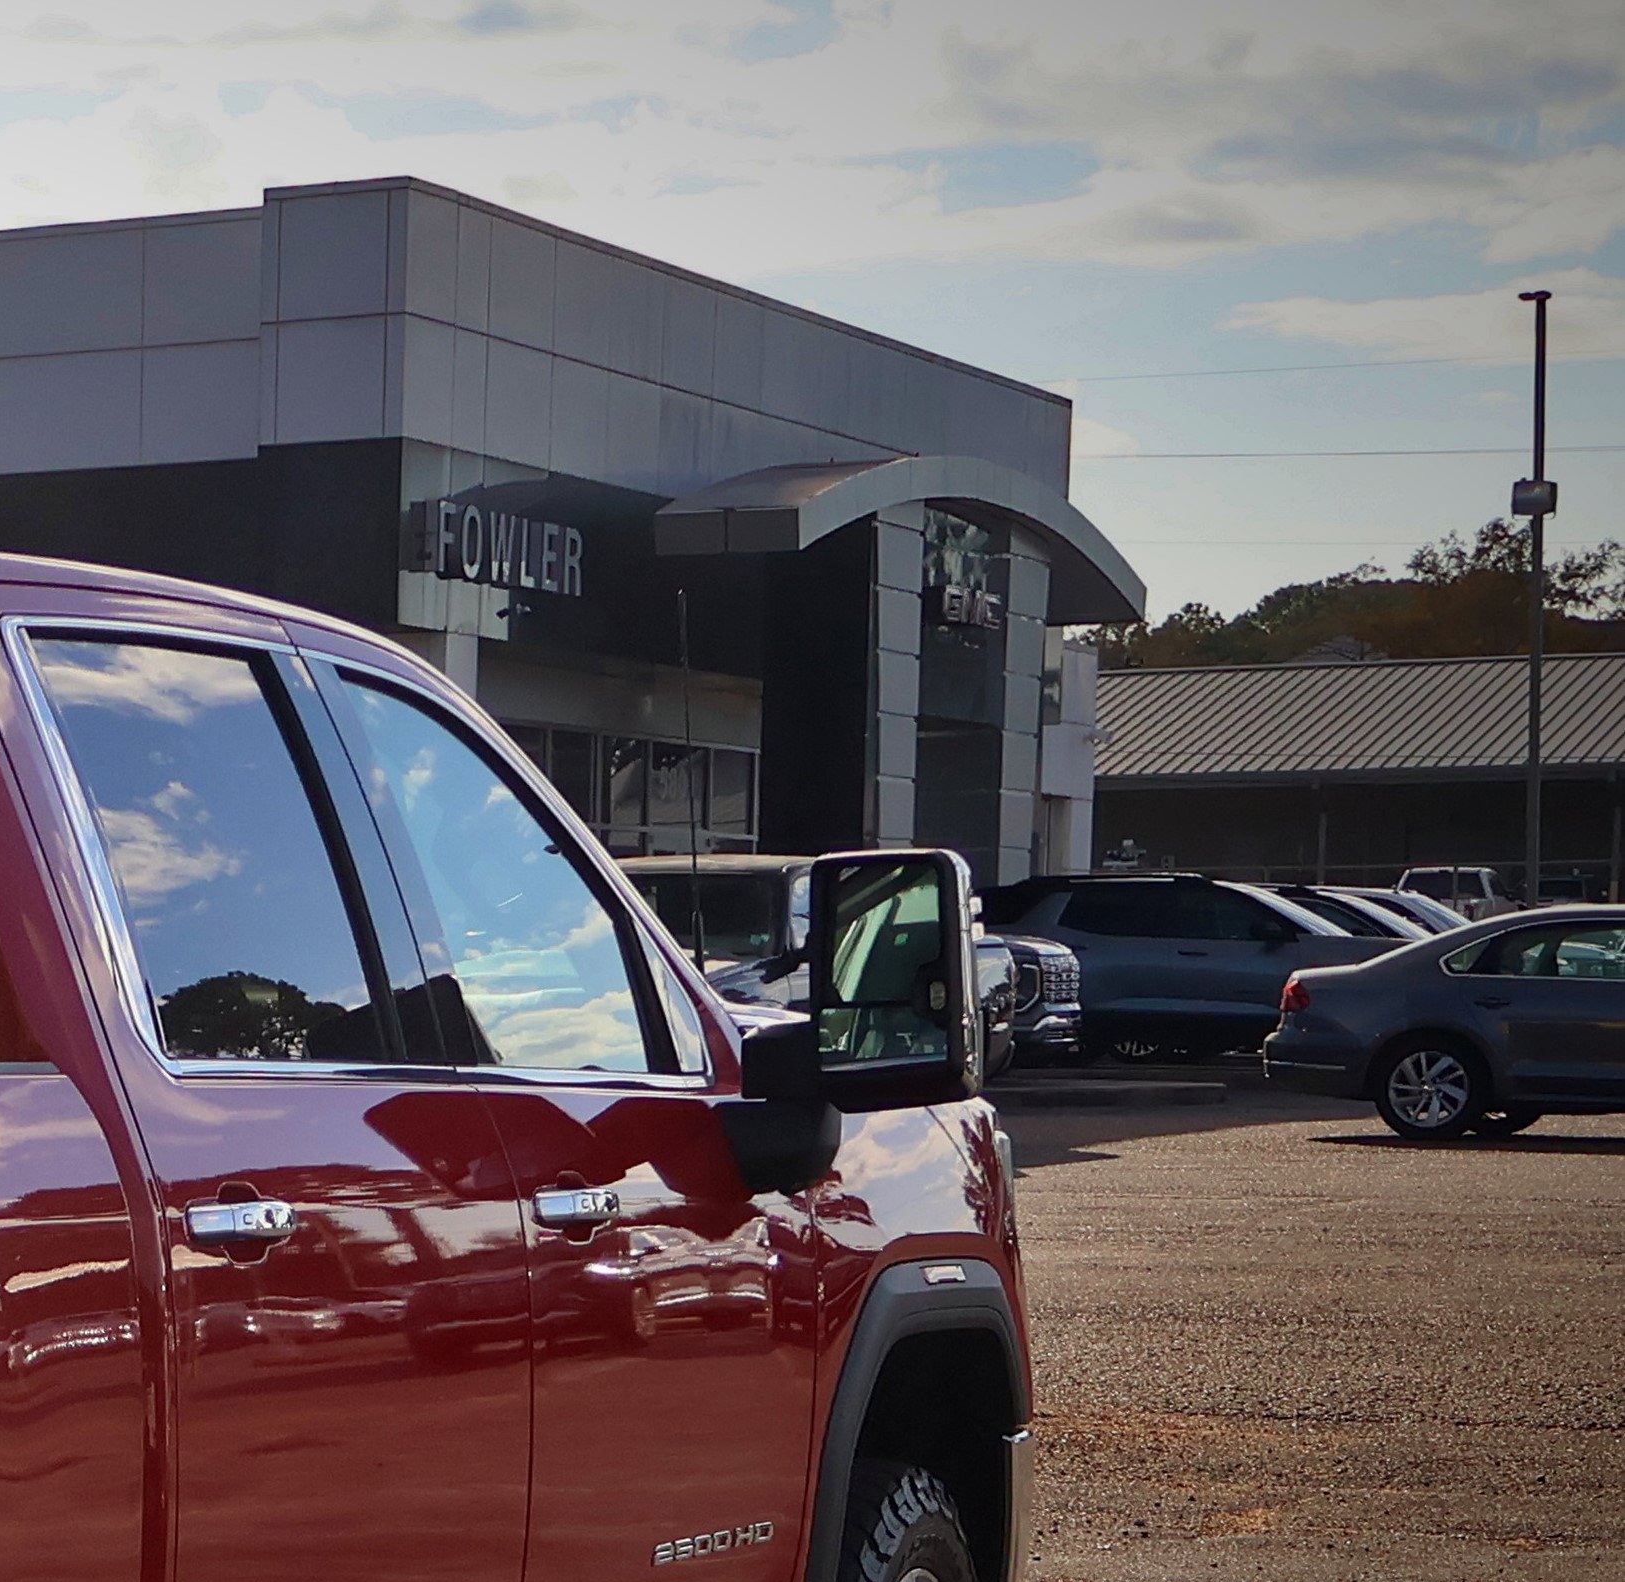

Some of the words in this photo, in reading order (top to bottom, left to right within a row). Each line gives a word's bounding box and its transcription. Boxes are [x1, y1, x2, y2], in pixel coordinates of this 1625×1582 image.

[437, 500, 583, 597] FOWLER
[943, 585, 1001, 630] GMC
[652, 1530, 733, 1566] 2500
[734, 1521, 776, 1549] HD
